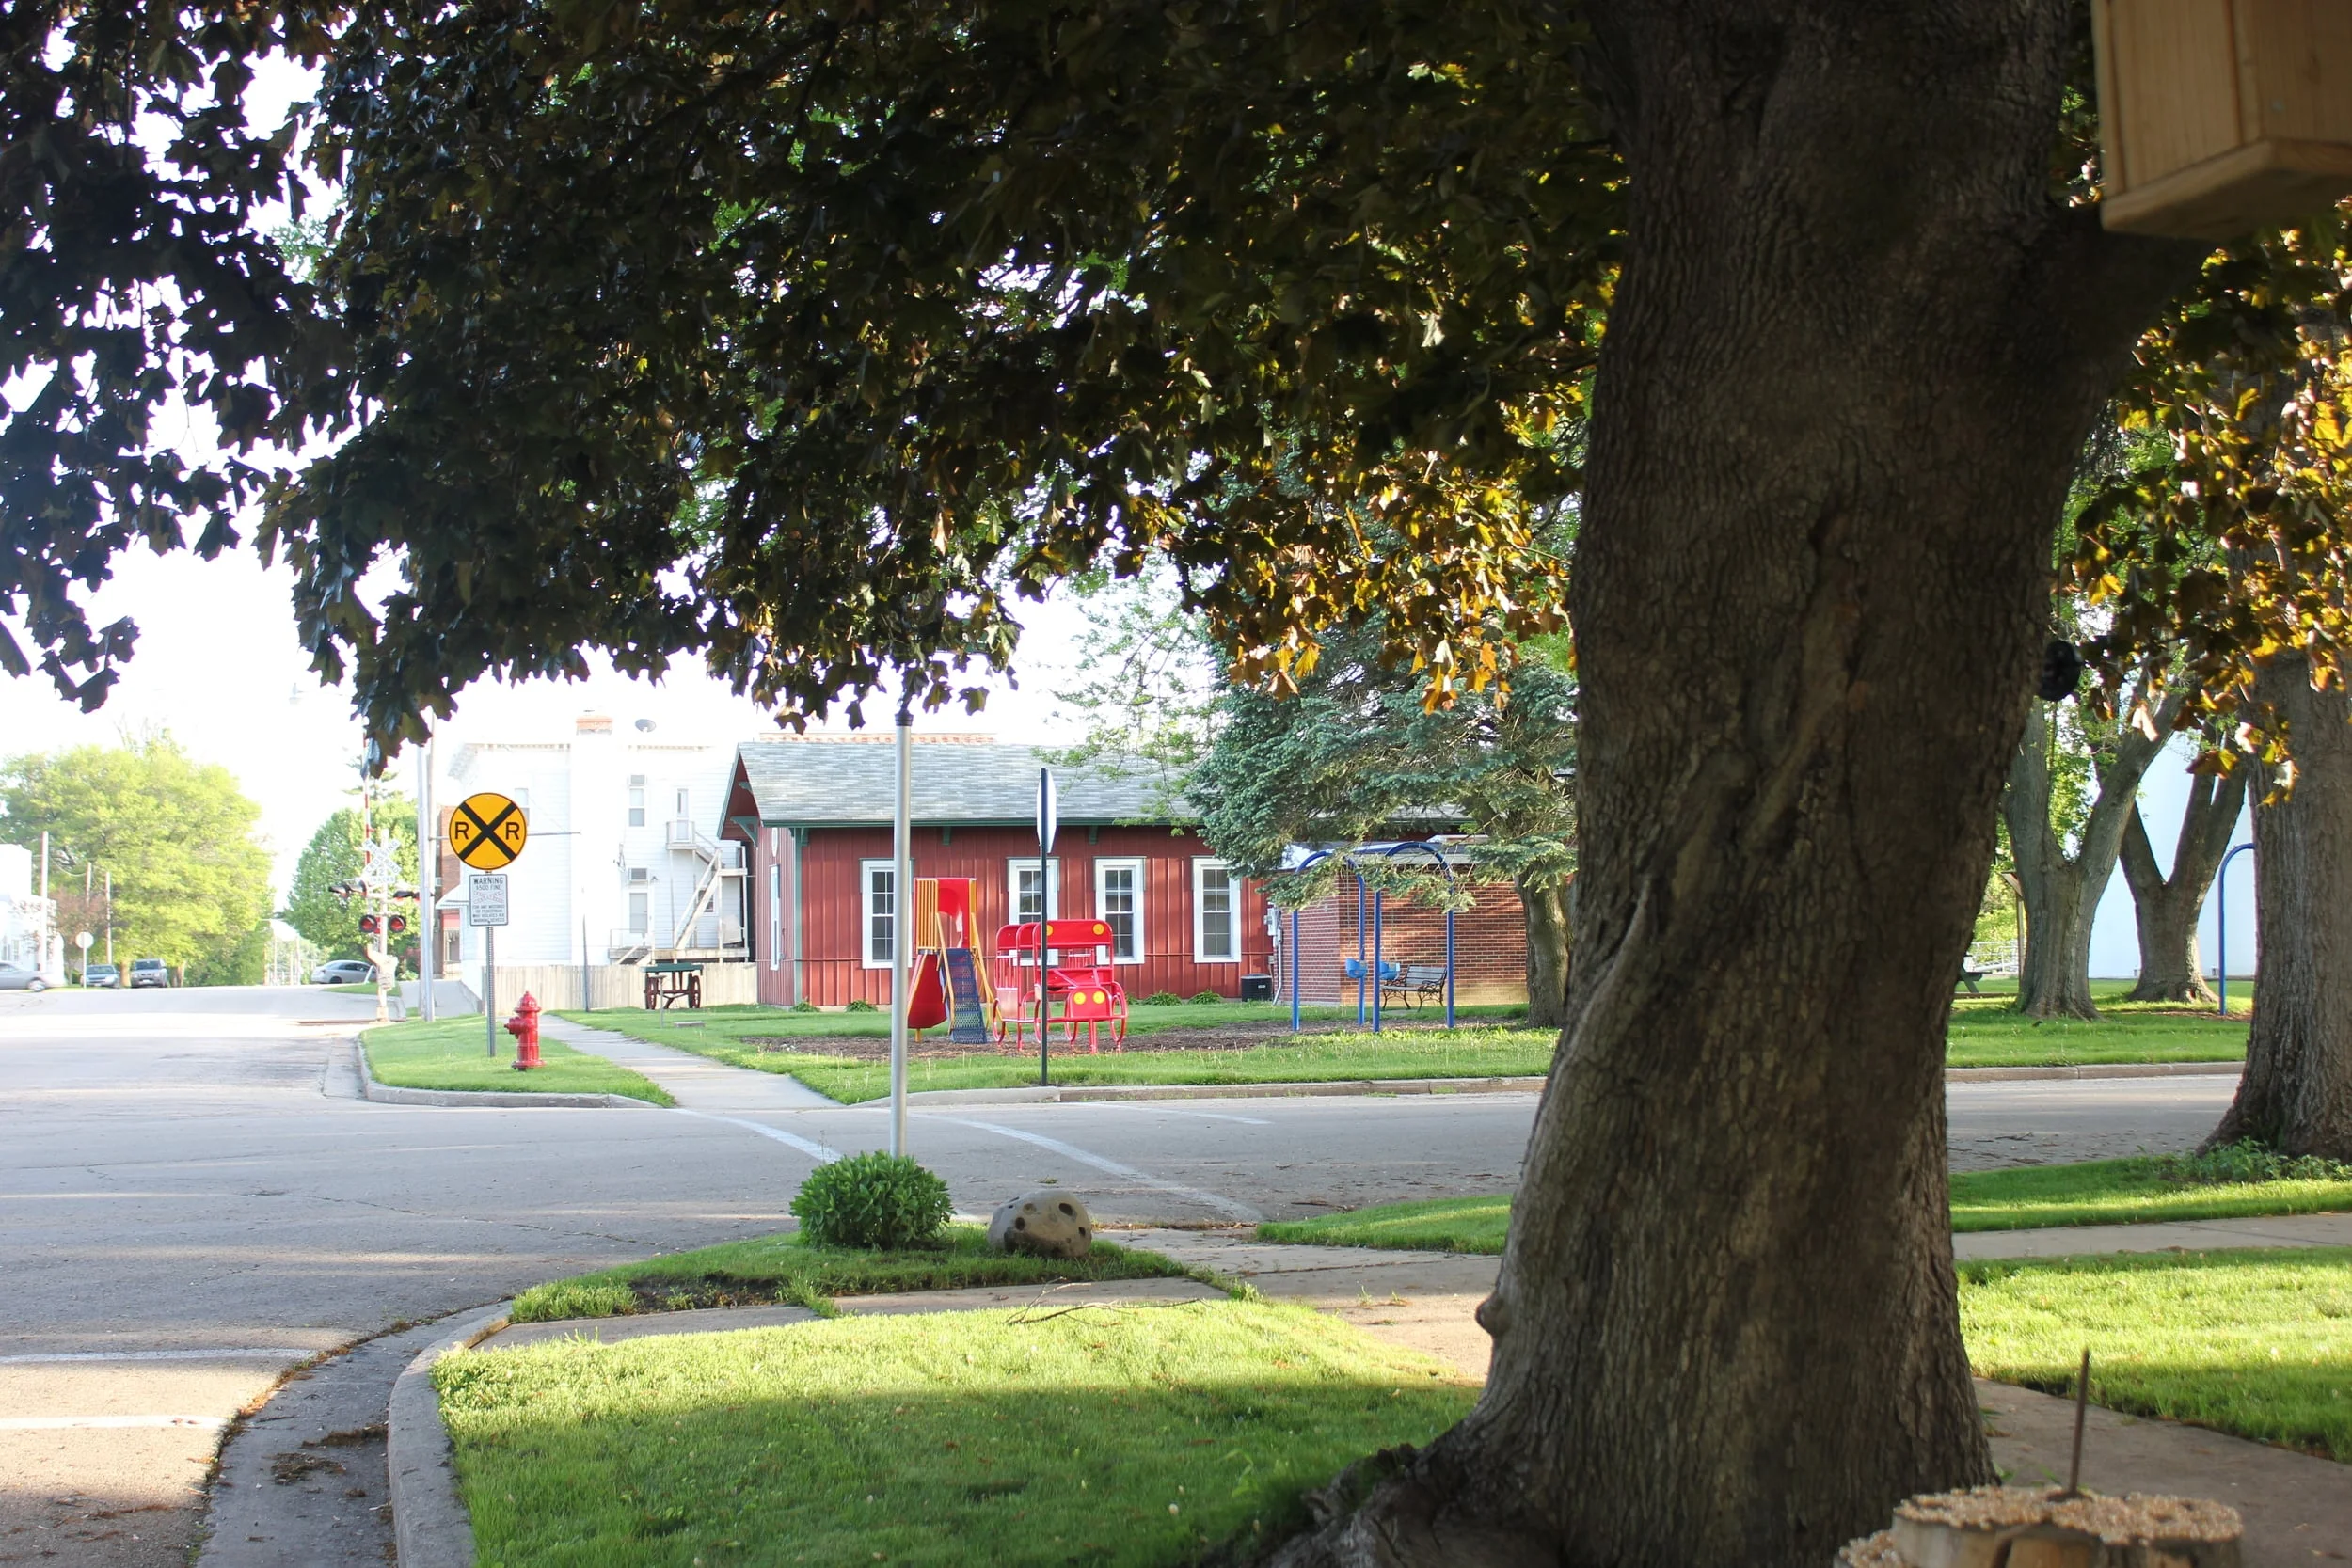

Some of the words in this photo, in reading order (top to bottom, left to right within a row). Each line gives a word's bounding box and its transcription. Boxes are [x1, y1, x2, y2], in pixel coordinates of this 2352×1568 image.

[455, 822, 469, 839] R
[506, 822, 519, 839] R
[366, 841, 397, 873] CROSSING
[384, 858, 399, 873] ROAD
